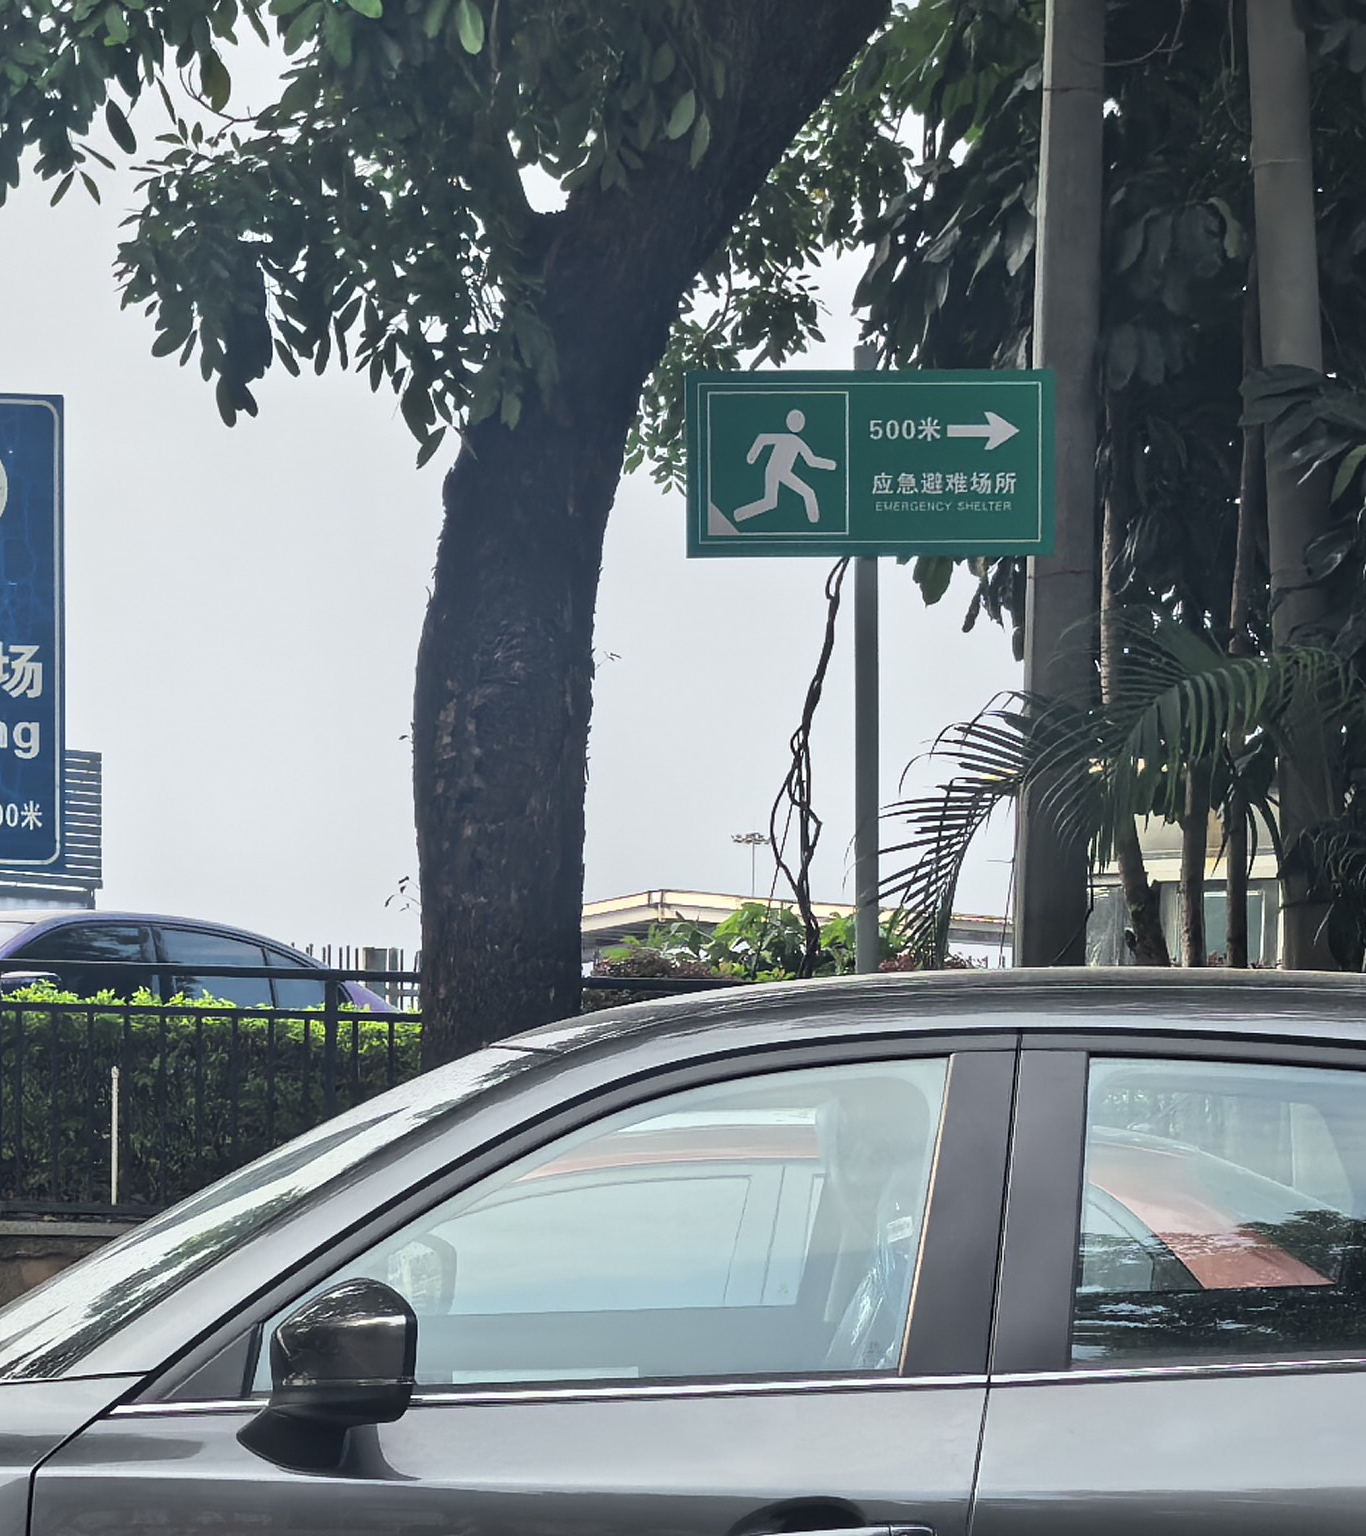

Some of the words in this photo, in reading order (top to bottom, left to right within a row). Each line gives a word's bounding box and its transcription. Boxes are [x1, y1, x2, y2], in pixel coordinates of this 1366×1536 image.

[869, 417, 941, 441] 500米
[872, 472, 1017, 494] 应急避难场所
[875, 501, 952, 511] EMERGENCY
[957, 501, 1012, 511] SHELTER
